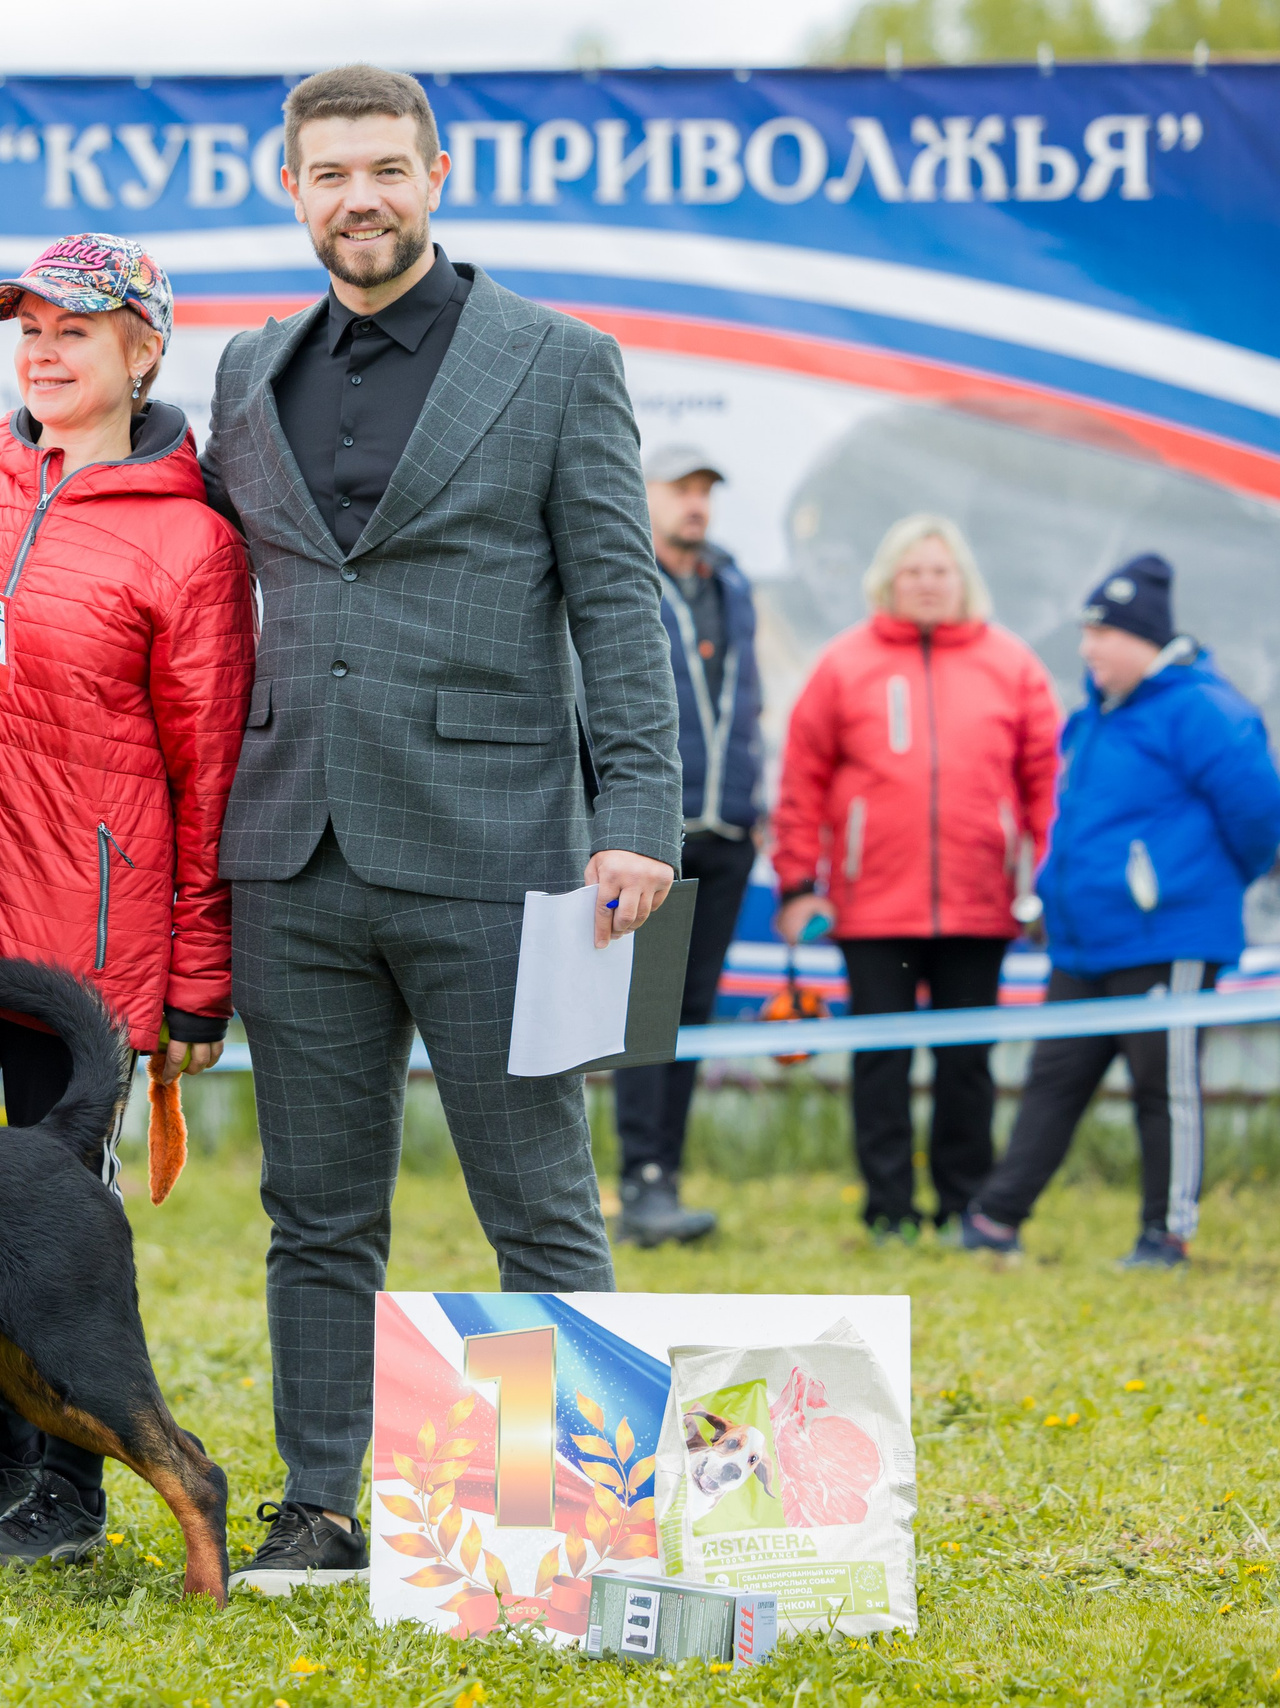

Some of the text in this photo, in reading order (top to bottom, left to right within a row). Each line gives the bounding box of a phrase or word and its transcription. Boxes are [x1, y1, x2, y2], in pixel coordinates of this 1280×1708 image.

[38, 239, 112, 265] adrid
[463, 1324, 558, 1530] 1
[719, 1533, 816, 1556] STATERA
[720, 1551, 800, 1565] 100% BALANCE
[741, 1567, 846, 1582] СБАЛАНСИРОВАННЫЙ КОРМ
[761, 1578, 808, 1589] ВЗРОСЛЫХ
[809, 1576, 836, 1586] СОБАК
[783, 1586, 813, 1596] ПОРОД
[777, 1599, 816, 1611] ЕНКОМ
[866, 1599, 886, 1609] 3 кг
[737, 1603, 755, 1666] Hitt
